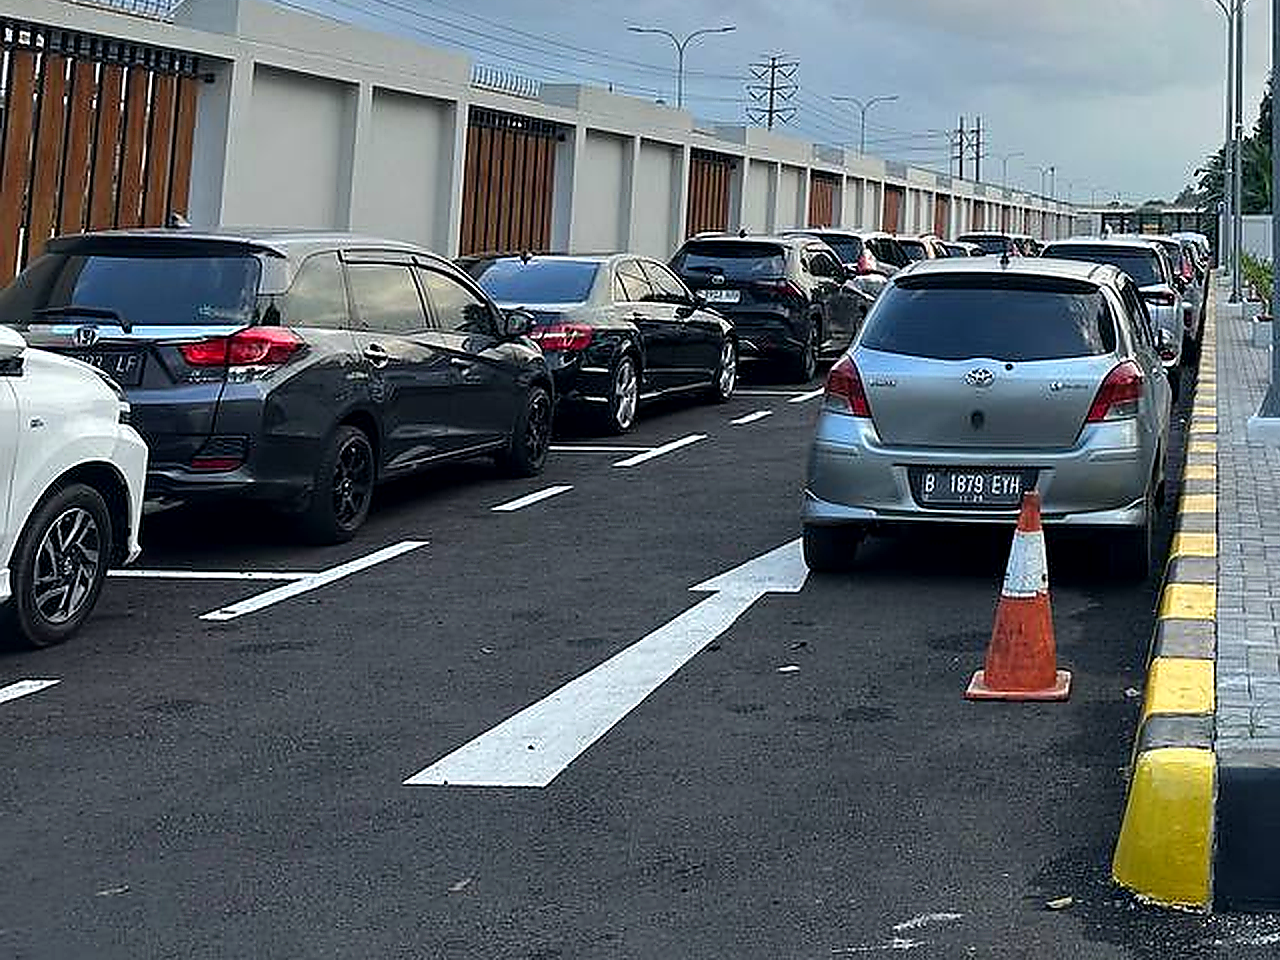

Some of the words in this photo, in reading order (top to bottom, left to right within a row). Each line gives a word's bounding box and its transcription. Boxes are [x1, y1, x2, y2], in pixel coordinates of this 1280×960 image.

[925, 473, 935, 493] B
[951, 474, 984, 494] 1879
[991, 474, 1019, 495] EYH
